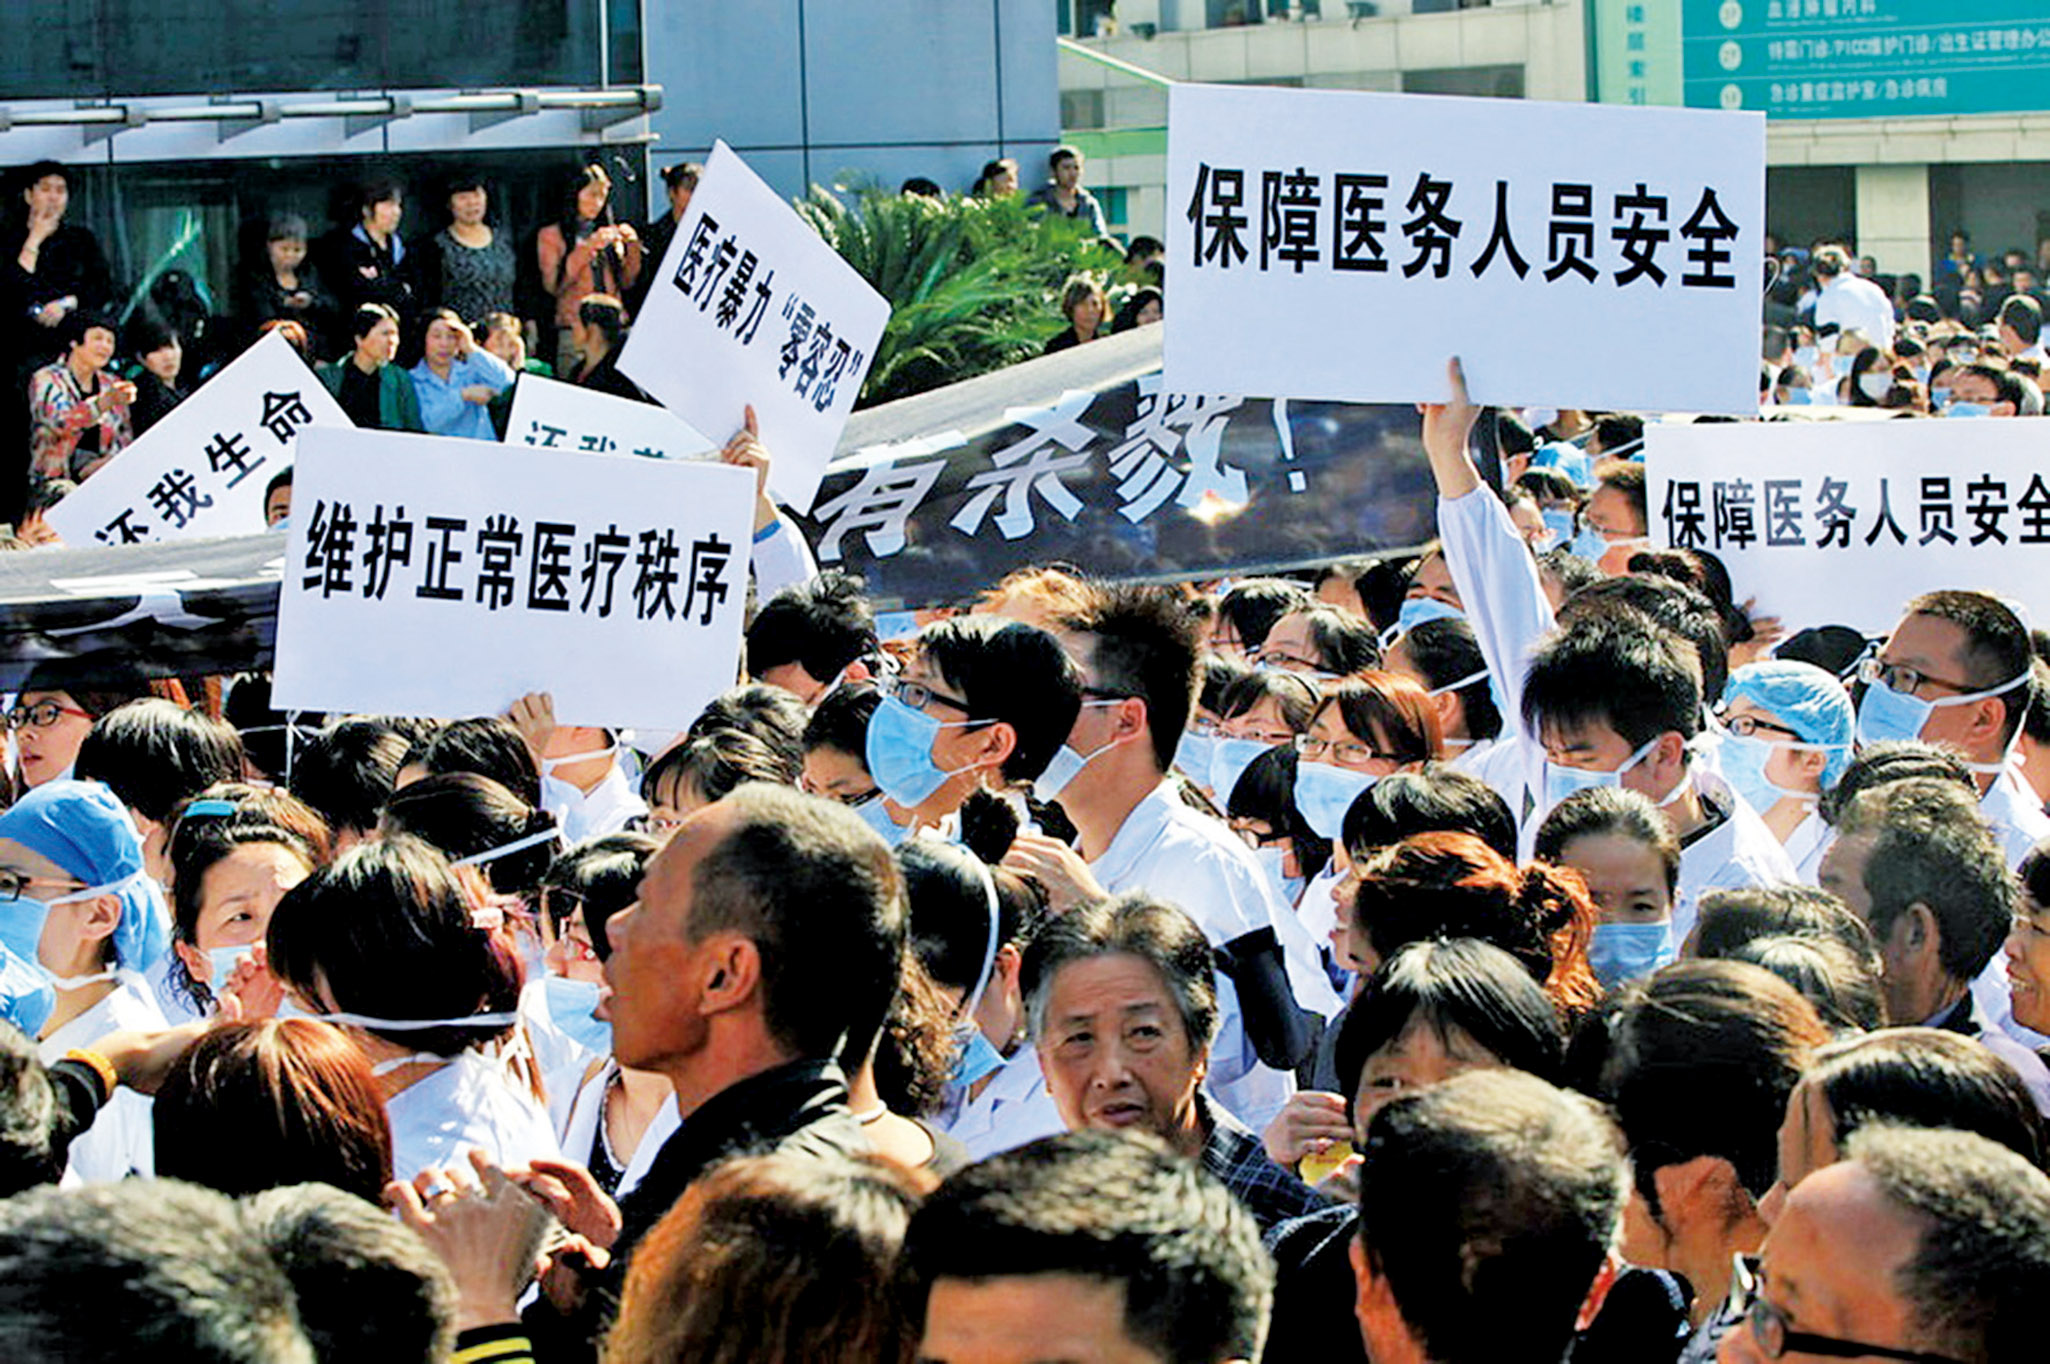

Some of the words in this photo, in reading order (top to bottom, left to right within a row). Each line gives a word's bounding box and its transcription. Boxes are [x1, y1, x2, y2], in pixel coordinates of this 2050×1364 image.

[1187, 161, 1740, 289] 保障医务人员安全
[302, 499, 732, 626] 维护正常医疗秩序
[1662, 473, 2050, 550] 保障医务人员安全
